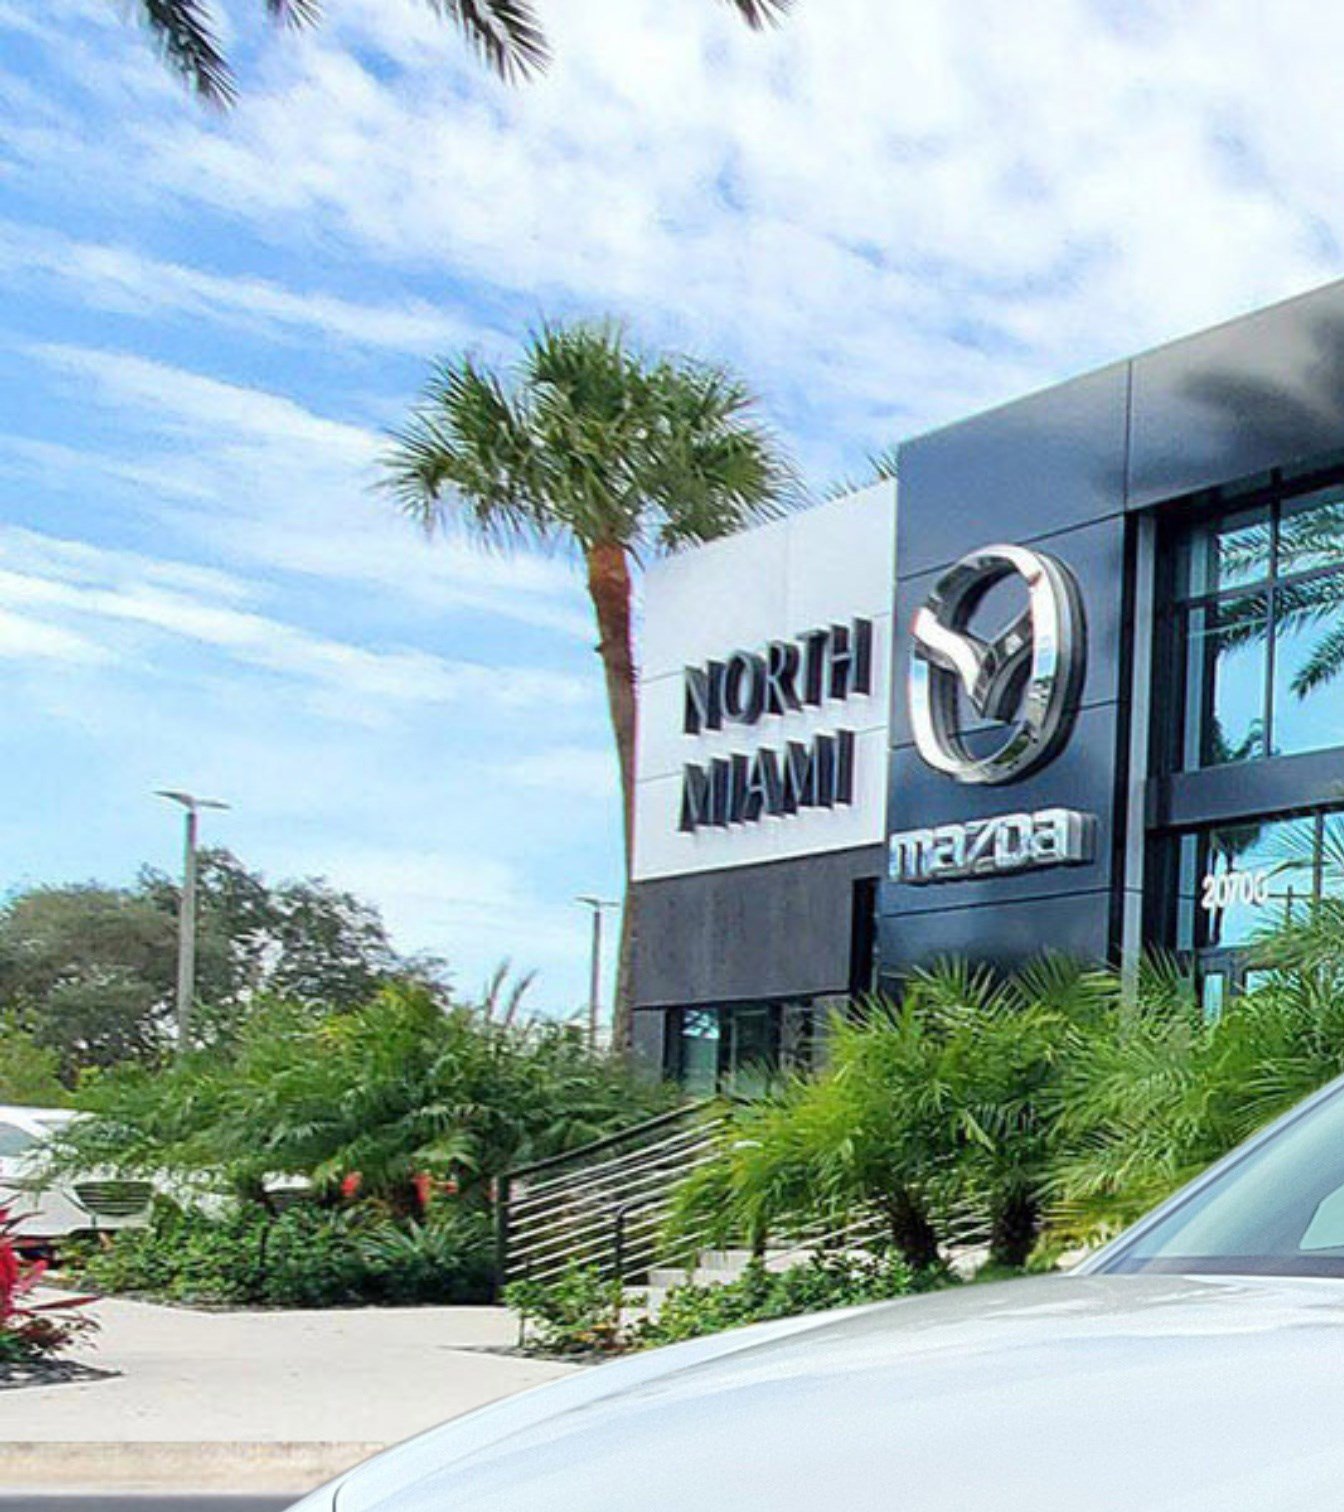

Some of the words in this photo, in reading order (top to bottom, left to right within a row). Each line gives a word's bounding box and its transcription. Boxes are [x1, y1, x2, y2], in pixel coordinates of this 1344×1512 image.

[684, 617, 873, 736] NORTH
[678, 729, 855, 832] MIAMI
[889, 808, 1088, 883] mazda
